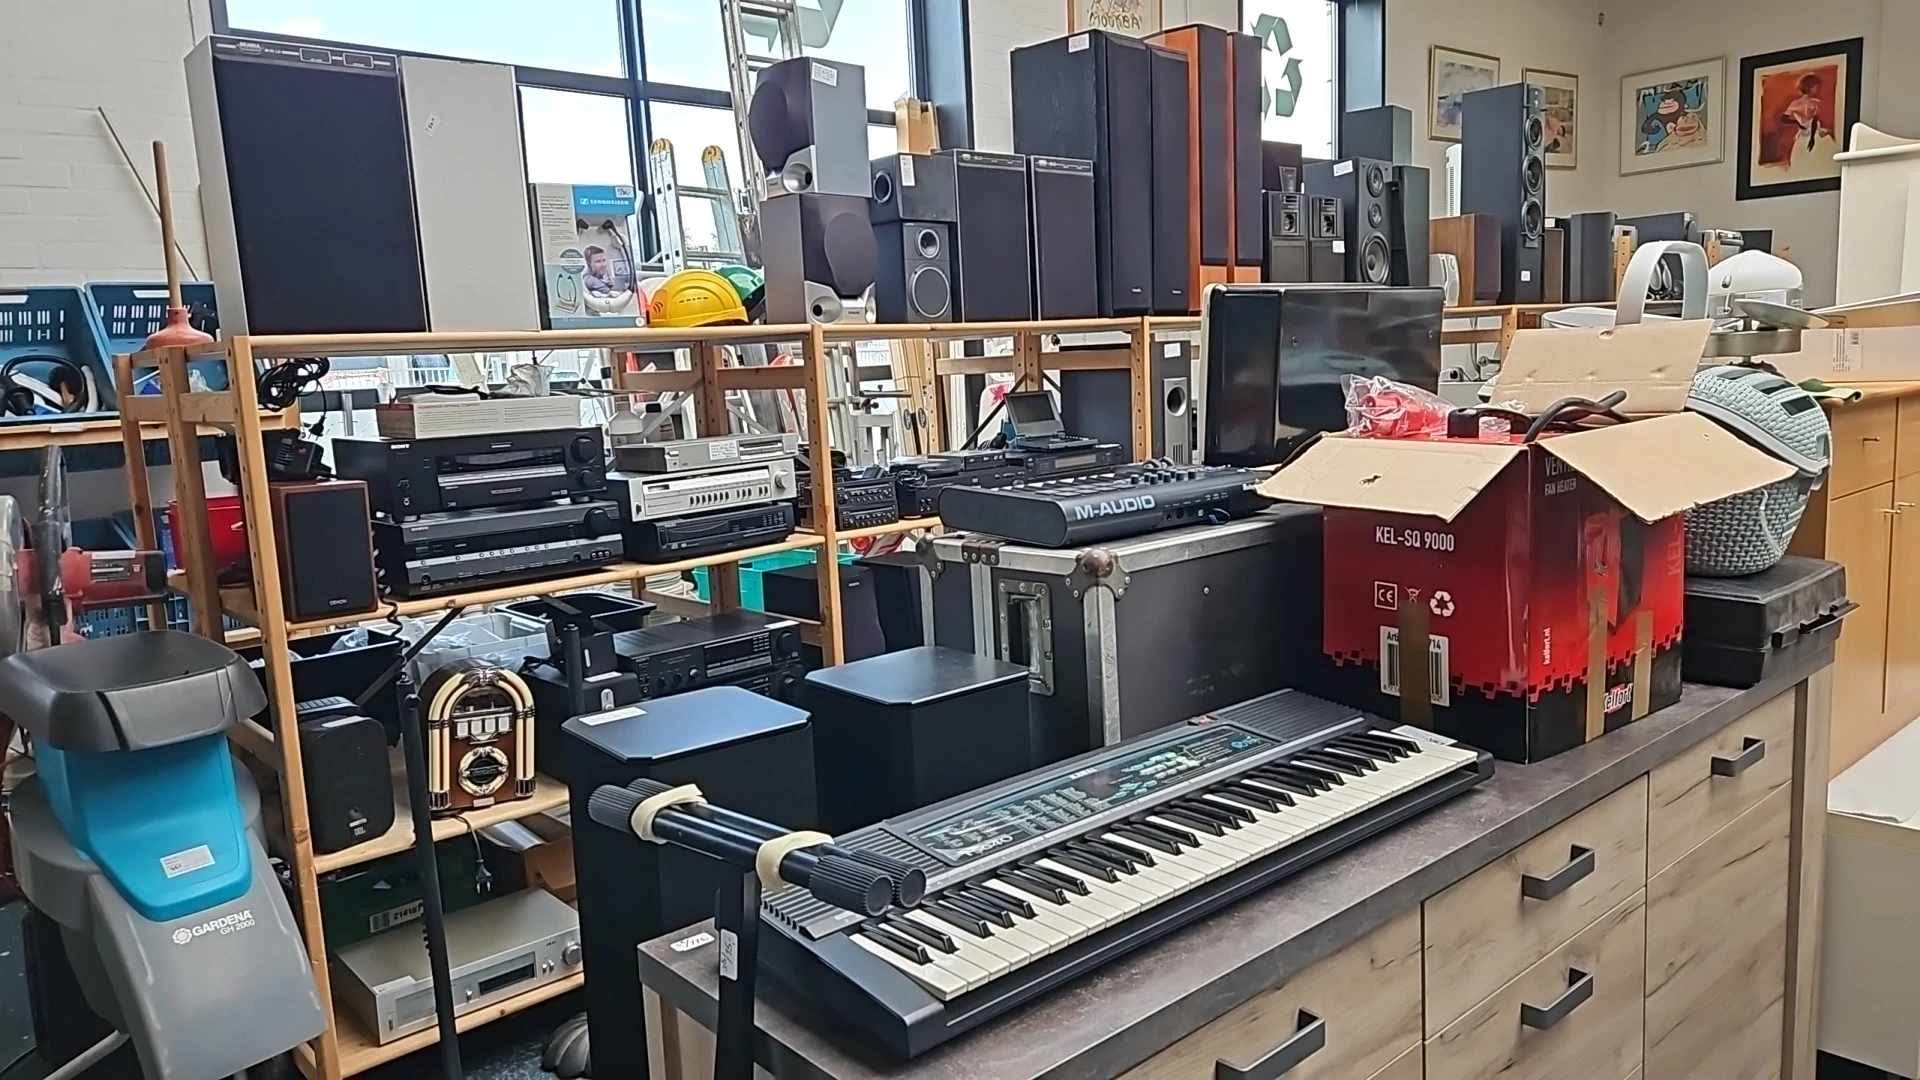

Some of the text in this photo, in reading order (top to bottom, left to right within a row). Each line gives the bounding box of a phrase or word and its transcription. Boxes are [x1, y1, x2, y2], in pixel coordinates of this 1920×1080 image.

[589, 198, 629, 206] SENNHEISER
[1544, 477, 1577, 497] FAN HEATER
[1074, 494, 1156, 521] M-AUDIO
[1375, 525, 1455, 552] KEL-SQ 9000
[1542, 627, 1551, 666] kelfort.nl
[192, 909, 253, 937] GARDENA
[219, 918, 256, 935] GH 2000
